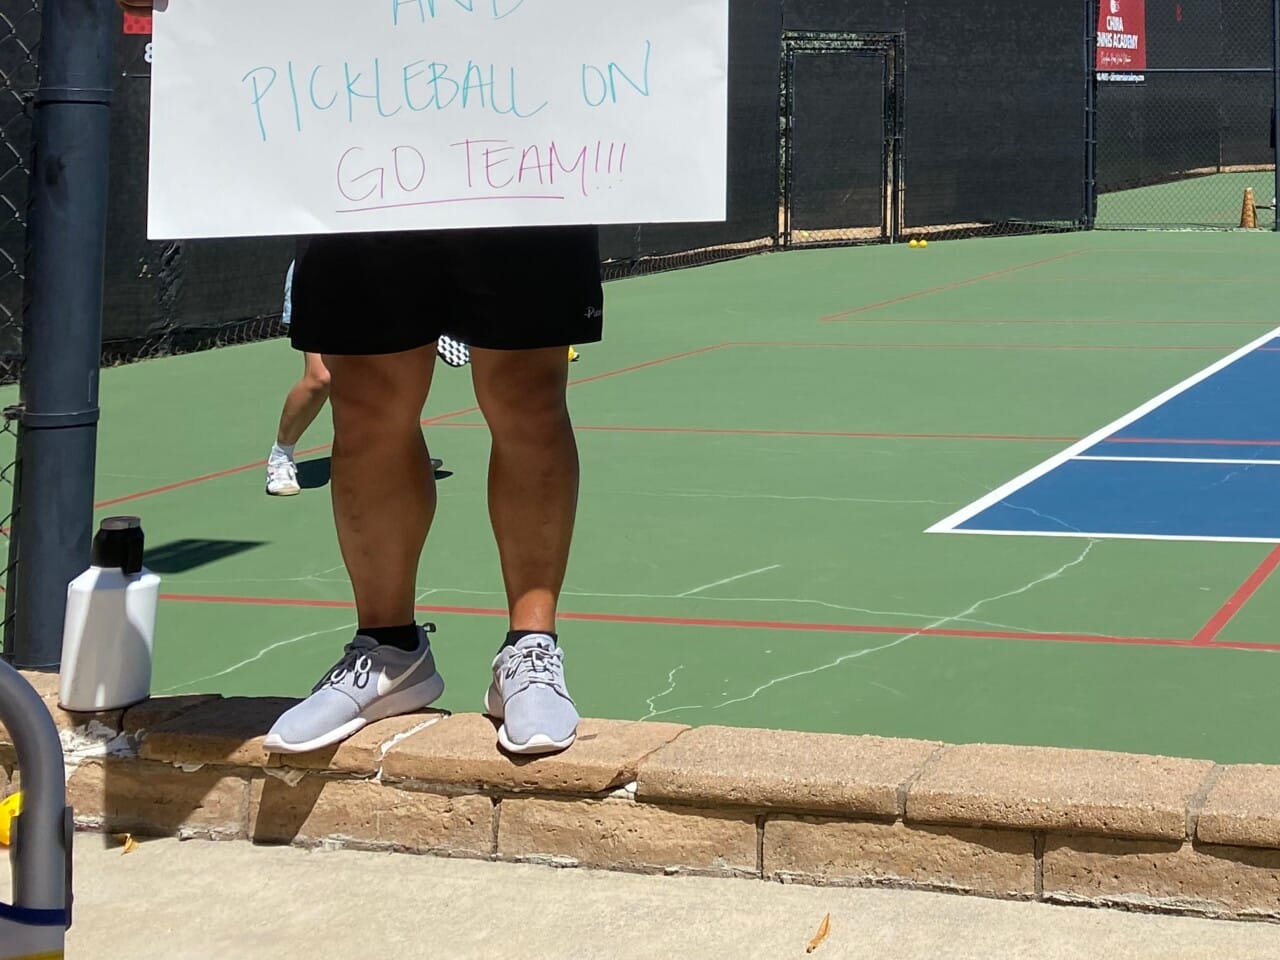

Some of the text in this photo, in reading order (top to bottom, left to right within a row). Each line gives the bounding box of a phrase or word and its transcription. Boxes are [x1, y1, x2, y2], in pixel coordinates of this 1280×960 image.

[241, 39, 652, 142] PICKLEBALL ON
[336, 139, 628, 202] GO TEAM!!!
